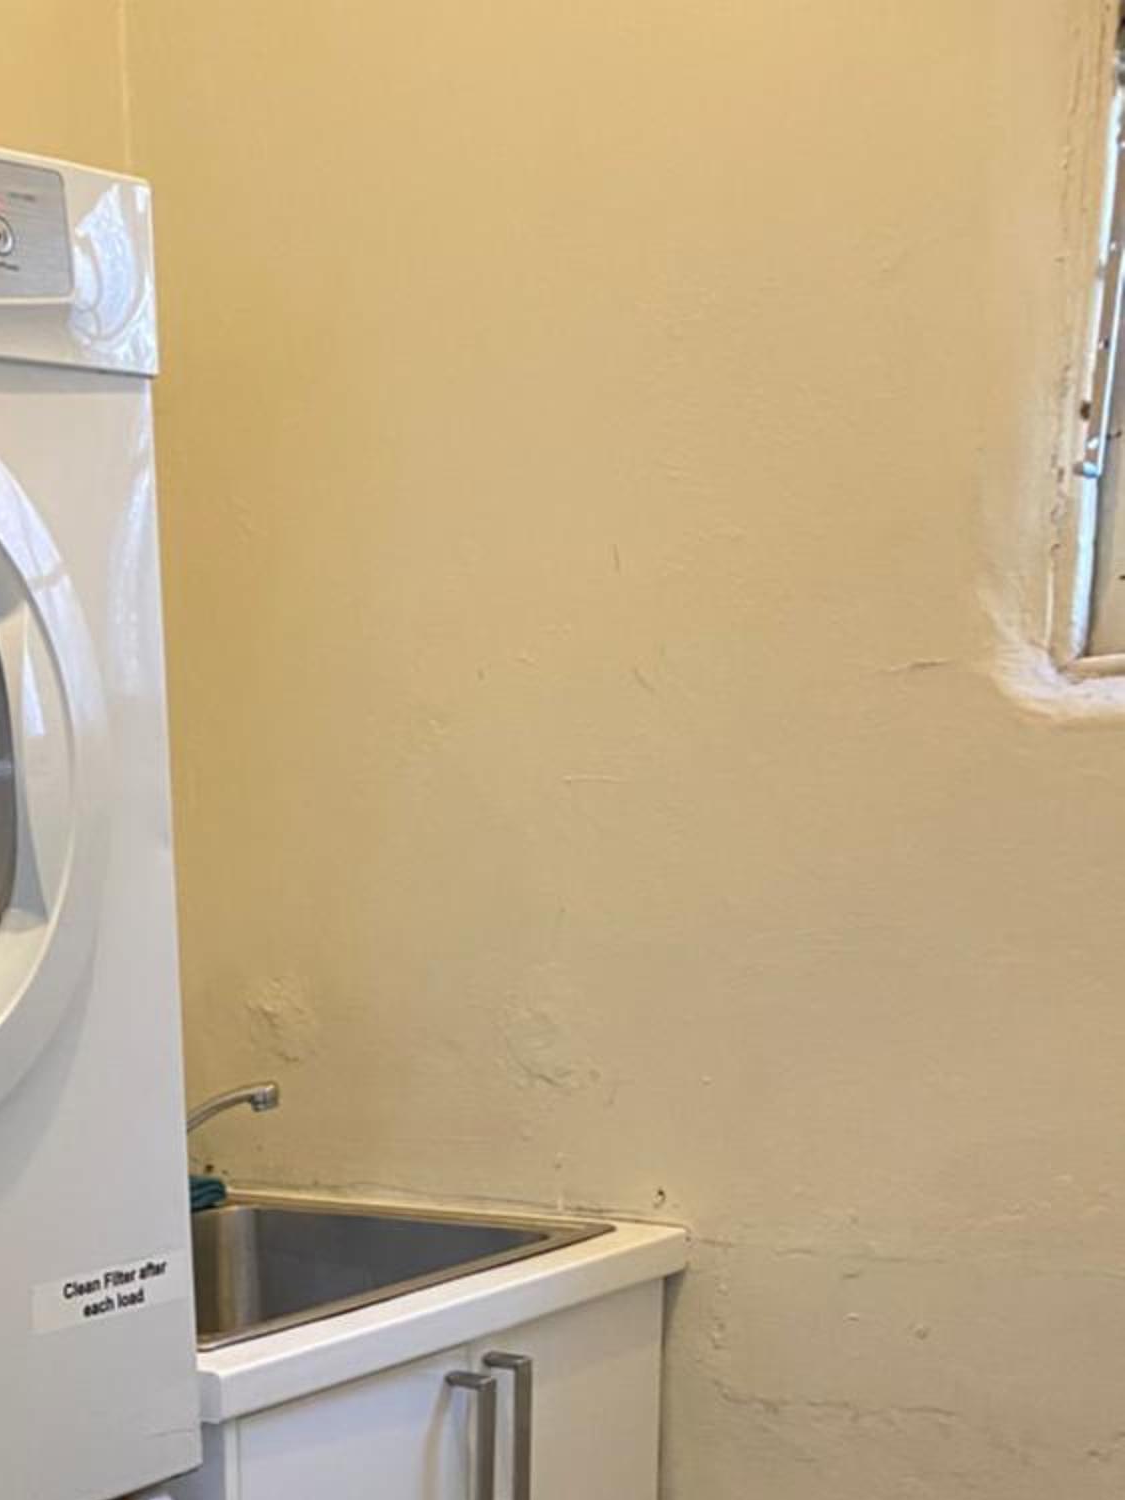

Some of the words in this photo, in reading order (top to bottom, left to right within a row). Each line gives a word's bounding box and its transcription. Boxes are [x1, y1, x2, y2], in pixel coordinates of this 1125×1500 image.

[63, 1279, 101, 1299] Clean
[104, 1269, 136, 1289] Filter
[139, 1261, 167, 1279] after
[83, 1297, 115, 1317] each
[117, 1287, 145, 1308] load
